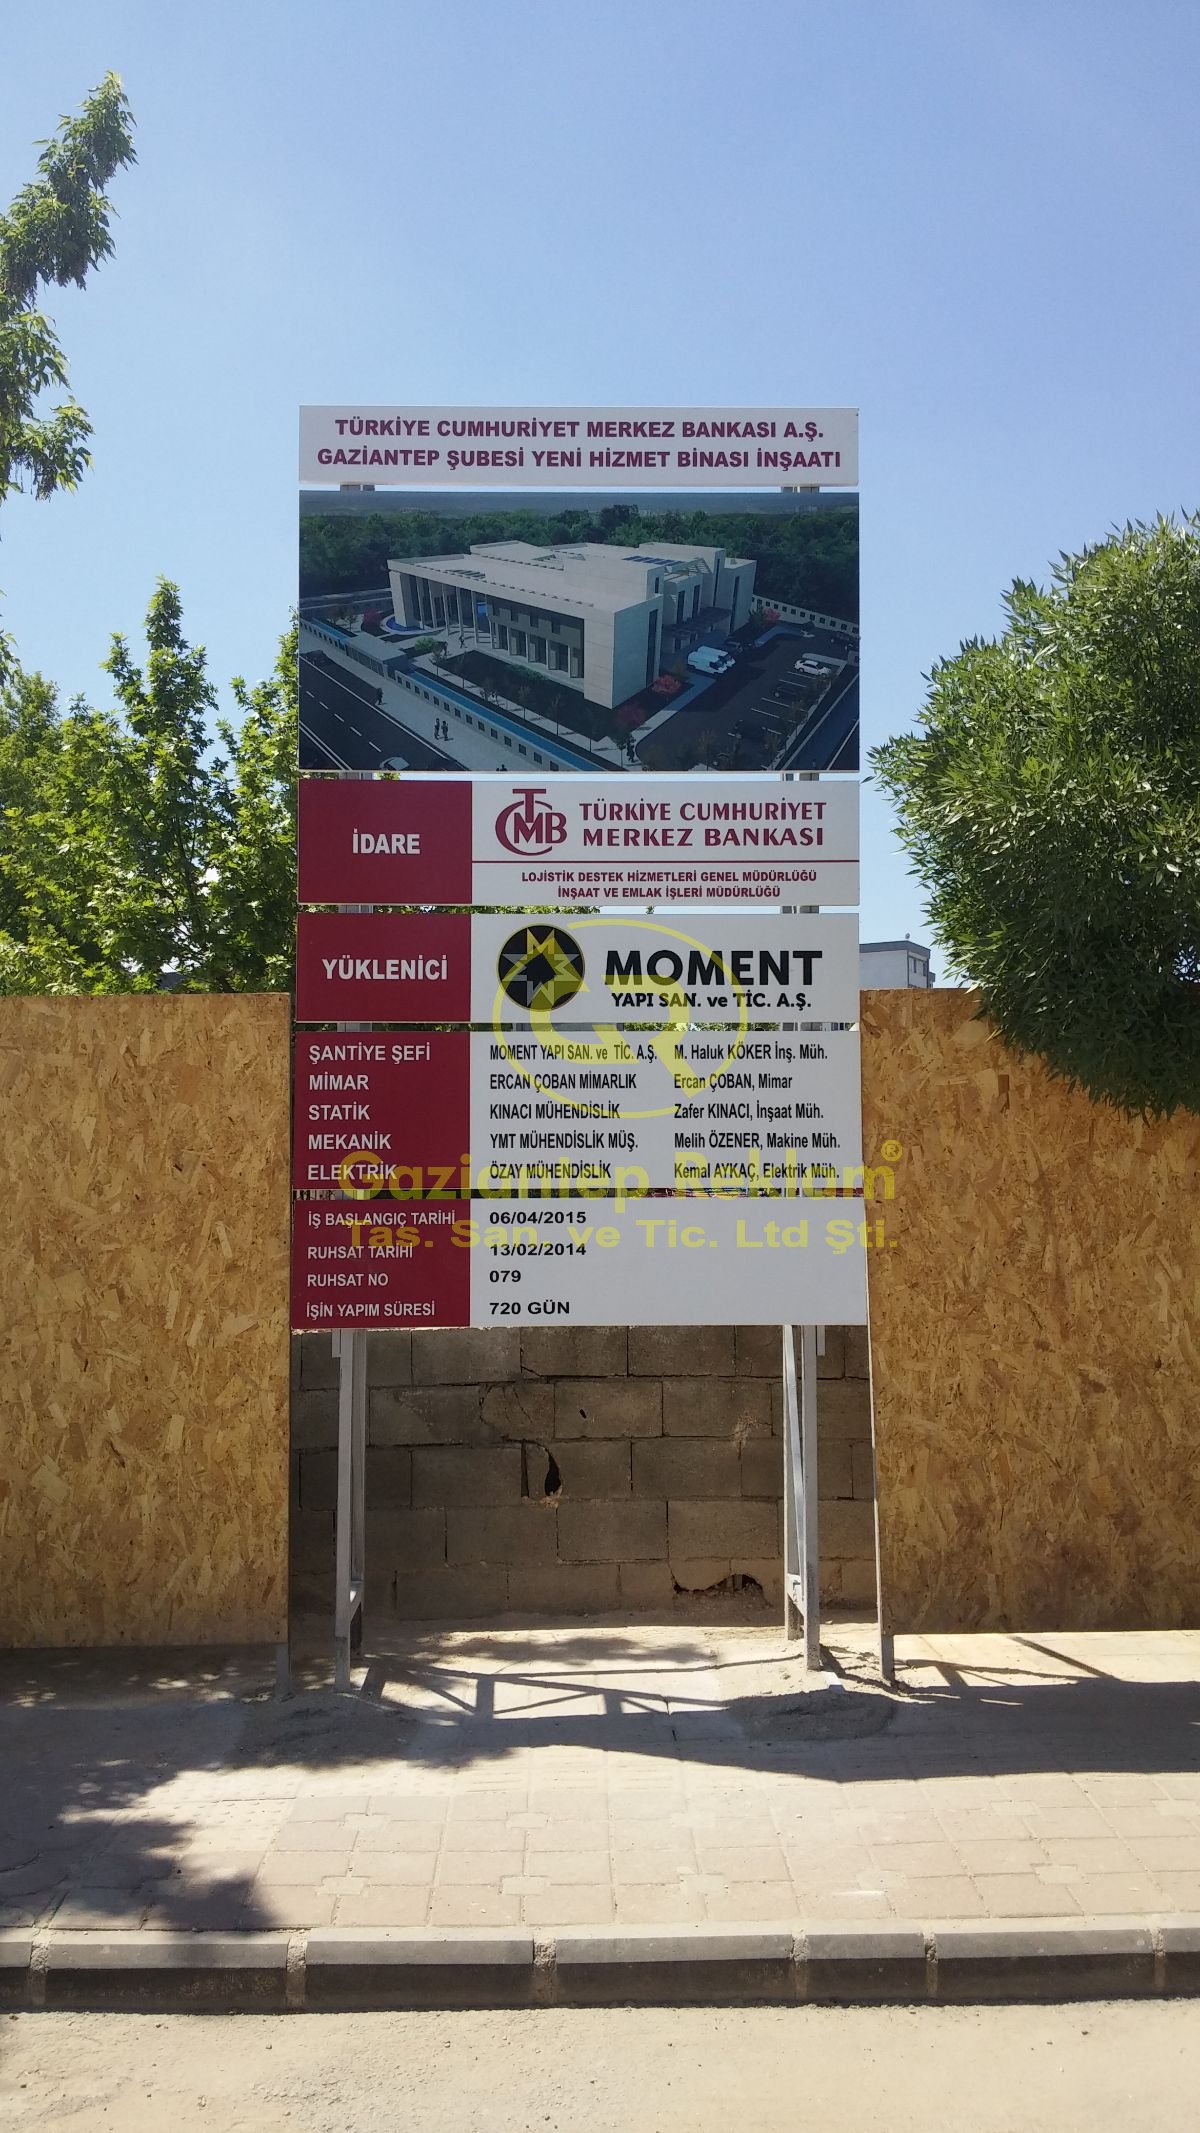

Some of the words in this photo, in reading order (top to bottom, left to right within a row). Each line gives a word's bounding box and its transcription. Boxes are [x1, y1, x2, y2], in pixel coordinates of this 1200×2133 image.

[335, 418, 430, 437] TÜRKİYE
[437, 418, 579, 438] CUMHURİYET
[587, 421, 675, 438] MERKEZ
[682, 422, 777, 438] BANKASI
[783, 422, 824, 442] A.Ş.
[318, 447, 440, 467] GAZİANTEP
[447, 447, 524, 470] ŞUBESİ
[531, 448, 582, 468] YENİ
[590, 448, 670, 468] HİZMET
[677, 448, 749, 468] BİNASI
[757, 449, 841, 472] İNŞAATI
[579, 799, 672, 821] TÜRKİYE
[680, 798, 826, 821] CUMHURİYET
[352, 829, 420, 854] İDARE
[584, 828, 692, 846] MERKEZ
[705, 828, 823, 846] BANKASI
[522, 868, 575, 883] LOJİSTİK
[579, 871, 624, 882] DESTEK
[628, 868, 697, 882] HİZMETLERİ
[701, 871, 742, 882] GENEL
[745, 868, 817, 882] MÜDÜRLÜĞÜ
[558, 885, 600, 900] İNŞAAT
[604, 887, 619, 898] VE
[623, 887, 662, 898] EMLAK
[666, 884, 702, 900] İŞLERİ
[706, 884, 781, 898] MÜDÜRLÜĞÜ
[322, 955, 448, 981] YÜKLENİCİ
[605, 951, 822, 985] MOMENT
[611, 994, 654, 1007] YAPI
[659, 993, 701, 1007] SAN.
[706, 997, 729, 1007] ve
[733, 990, 771, 1008] TİC.
[777, 993, 812, 1013] A.Ş.
[309, 1042, 386, 1064] ŞANTİYE
[391, 1042, 430, 1064] ŞEFİ
[490, 1045, 537, 1060] MOMENT
[541, 1045, 565, 1059] YAPI
[567, 1045, 593, 1059] SAN.
[596, 1049, 607, 1059] ve
[615, 1041, 634, 1059] TİC.
[637, 1045, 657, 1064] A.Ş.
[675, 1045, 687, 1059] M.
[691, 1044, 724, 1059] Haluk
[728, 1041, 772, 1059] KÖKER
[775, 1041, 796, 1063] İnş.
[800, 1044, 828, 1059] Müh.
[309, 1072, 369, 1090] MİMAR
[490, 1074, 530, 1089] ERCAN
[534, 1074, 576, 1093] ÇOBAN
[579, 1070, 637, 1089] MİMARLIK
[674, 1074, 706, 1089] Ercan
[709, 1073, 755, 1092] ÇOBAN,
[758, 1073, 792, 1089] Mimar
[309, 1102, 370, 1120] STATİK
[490, 1104, 532, 1119] KINACI
[535, 1101, 620, 1119] MÜHENDİSLİK
[674, 1103, 705, 1119] Zafer
[708, 1104, 753, 1121] KINACI,
[757, 1101, 792, 1121] İnşaat
[795, 1102, 824, 1118] Müh.
[308, 1131, 392, 1150] MEKANİK
[490, 1134, 516, 1149] YMT
[520, 1130, 604, 1149] MÜHENDİSLİK
[608, 1131, 638, 1152] MÜŞ.
[675, 1133, 705, 1148] Melih
[709, 1130, 763, 1150] ÖZENER,
[767, 1133, 808, 1148] Makine
[812, 1133, 840, 1148] Müh.
[308, 1161, 398, 1180] ELEKTRİK
[490, 1160, 522, 1179] ÖZAY
[526, 1159, 611, 1179] MÜHENDİSLİK
[674, 1163, 711, 1179] Kemal
[714, 1163, 759, 1182] AYKAÇ,
[763, 1162, 807, 1178] Elektrik
[811, 1162, 840, 1178] Müh.
[308, 1211, 321, 1228] İŞ
[325, 1213, 407, 1228] BAŞLANGIÇ
[411, 1210, 455, 1224] TARİHİ
[489, 1211, 586, 1224] 06/04/2015
[308, 1246, 364, 1259] RUHSAT
[368, 1243, 413, 1258] TARİHİ
[490, 1243, 586, 1256] 13/02/2014
[308, 1274, 364, 1287] RUHSAT
[368, 1274, 388, 1286] NO
[489, 1270, 521, 1283] 079
[306, 1304, 333, 1320] İŞİN
[337, 1304, 379, 1317] YAPIM
[384, 1300, 435, 1316] SÜRESİ
[489, 1302, 521, 1315] 720
[527, 1298, 570, 1315] GÜN
